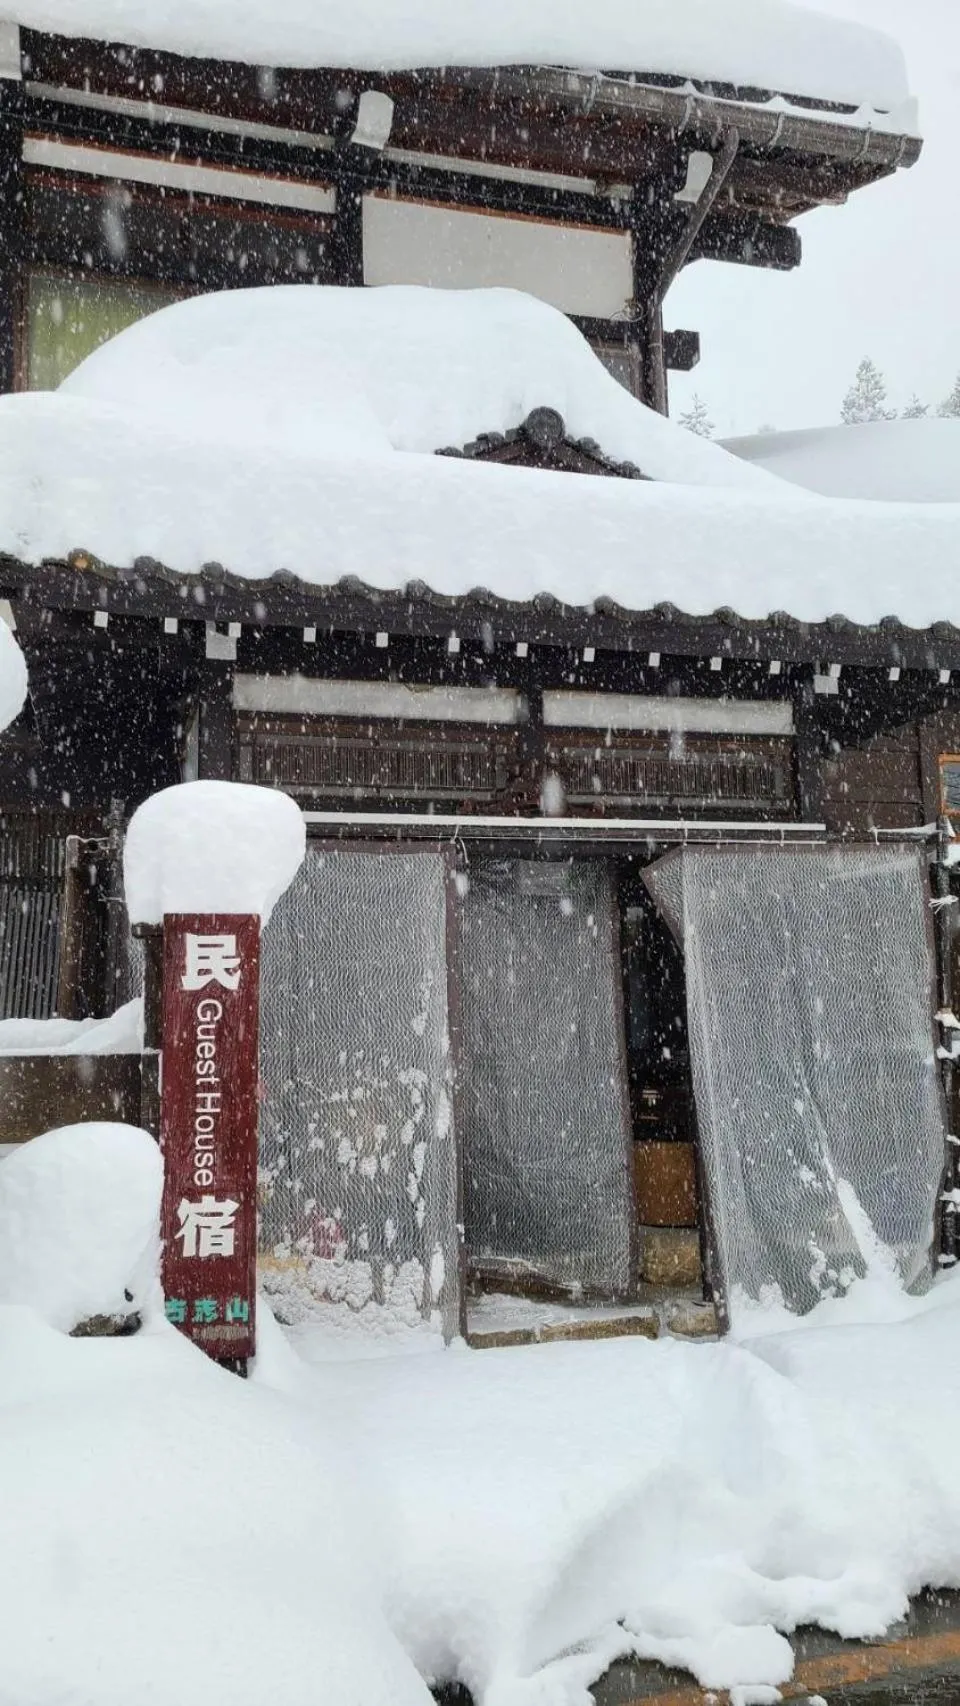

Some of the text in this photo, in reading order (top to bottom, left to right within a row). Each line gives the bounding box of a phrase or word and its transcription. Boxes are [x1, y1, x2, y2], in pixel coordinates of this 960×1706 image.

[181, 932, 241, 991] 民
[193, 998, 223, 1186] Guest House
[174, 1194, 240, 1258] 宿
